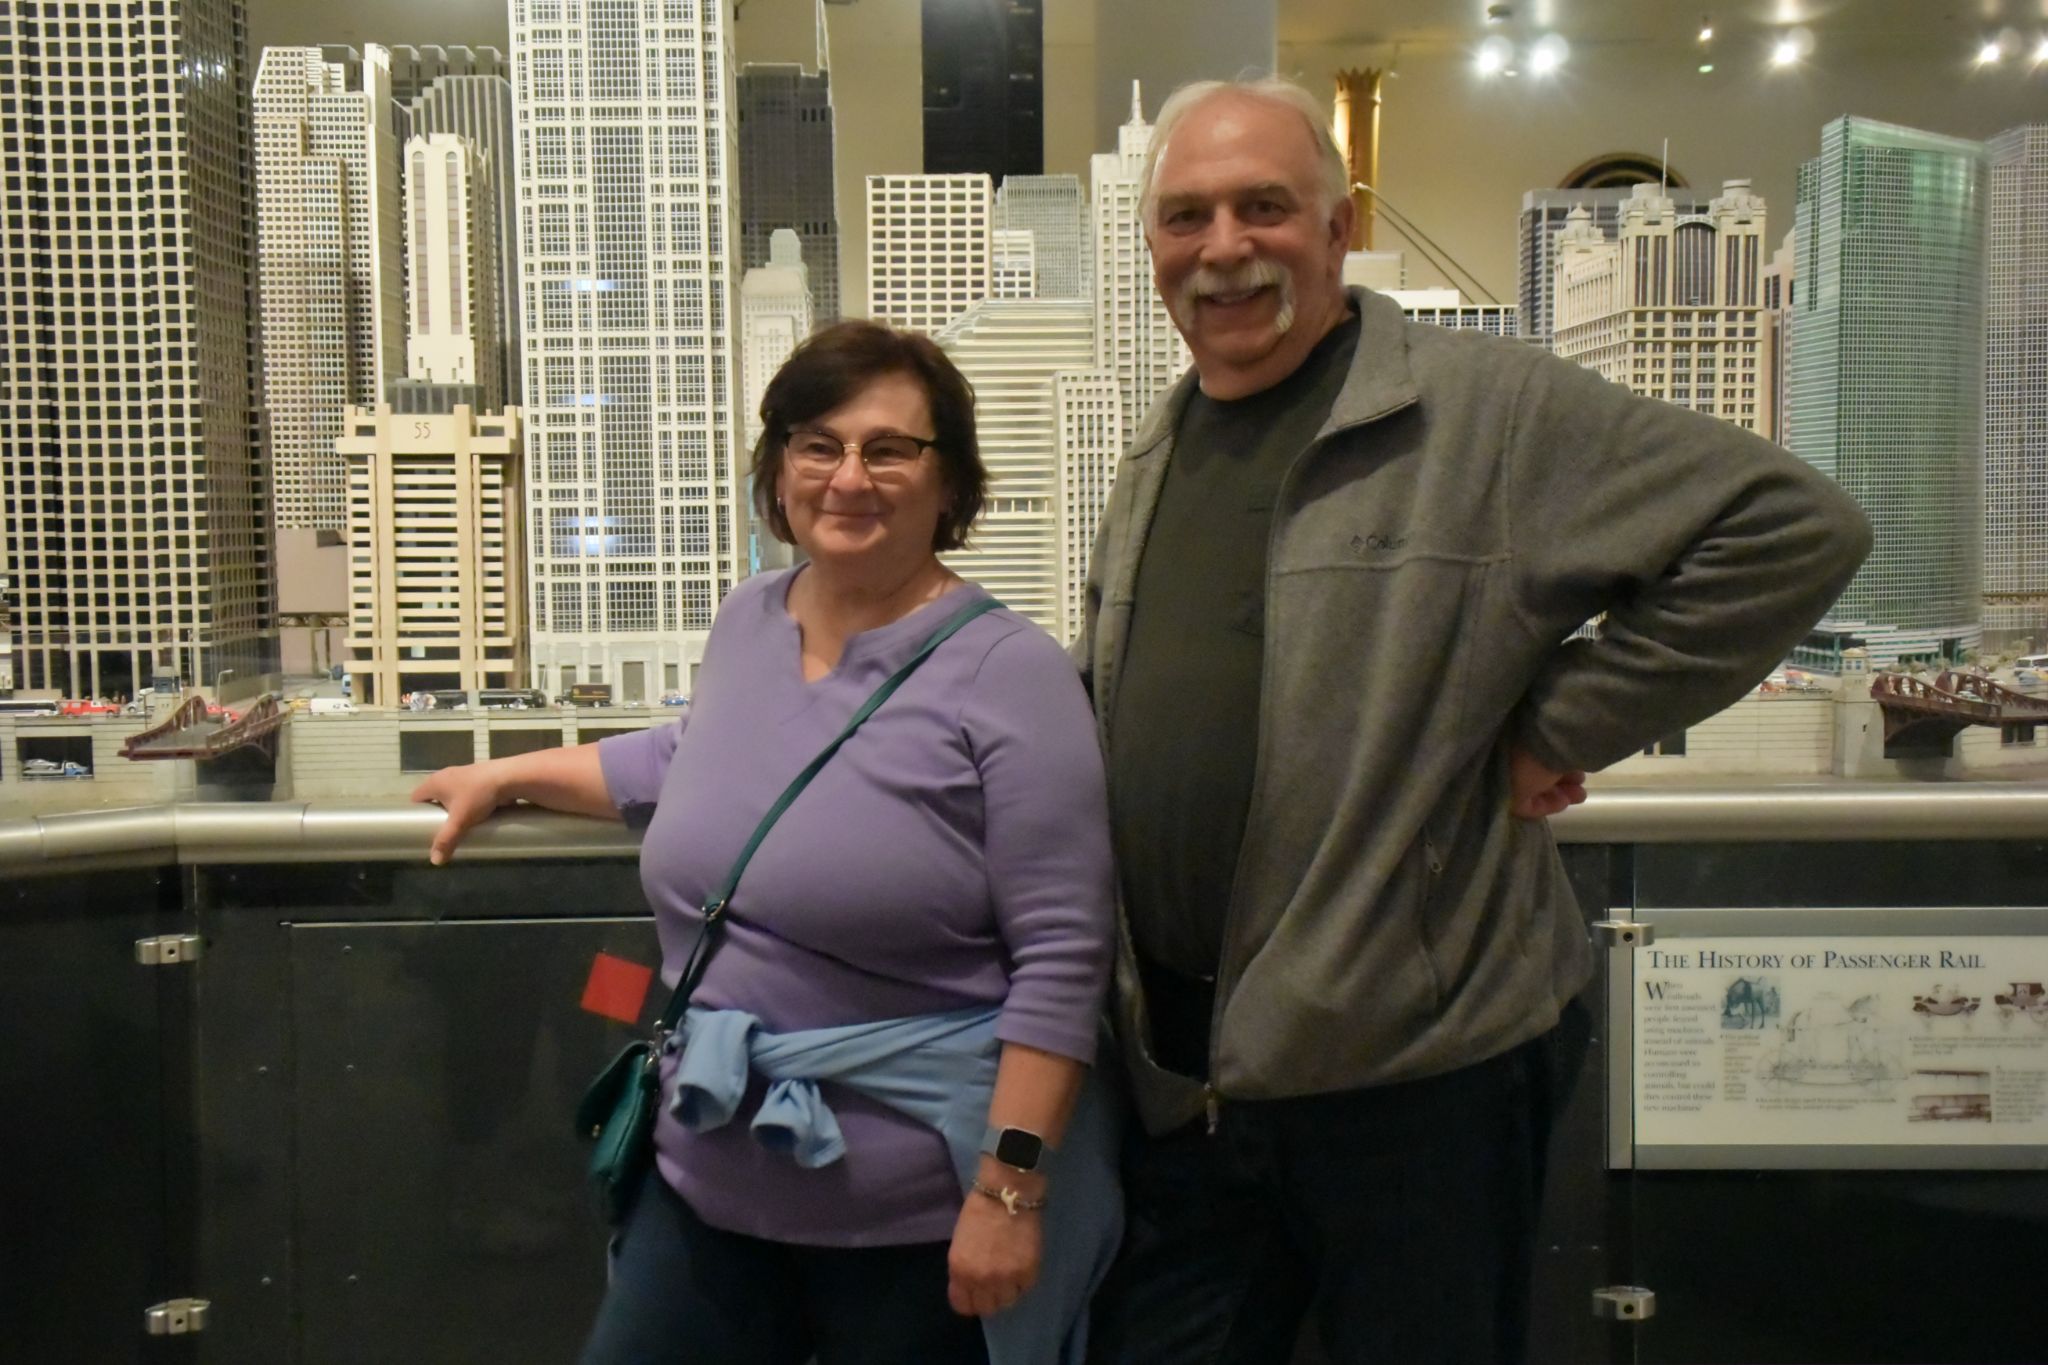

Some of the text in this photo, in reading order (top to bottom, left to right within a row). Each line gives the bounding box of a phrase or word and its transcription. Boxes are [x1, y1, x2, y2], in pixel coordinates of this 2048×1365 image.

[414, 422, 431, 439] 55
[1698, 951, 1784, 968] HISTORY
[1823, 951, 1931, 968] PASSENGER
[1939, 951, 1986, 968] RAIL
